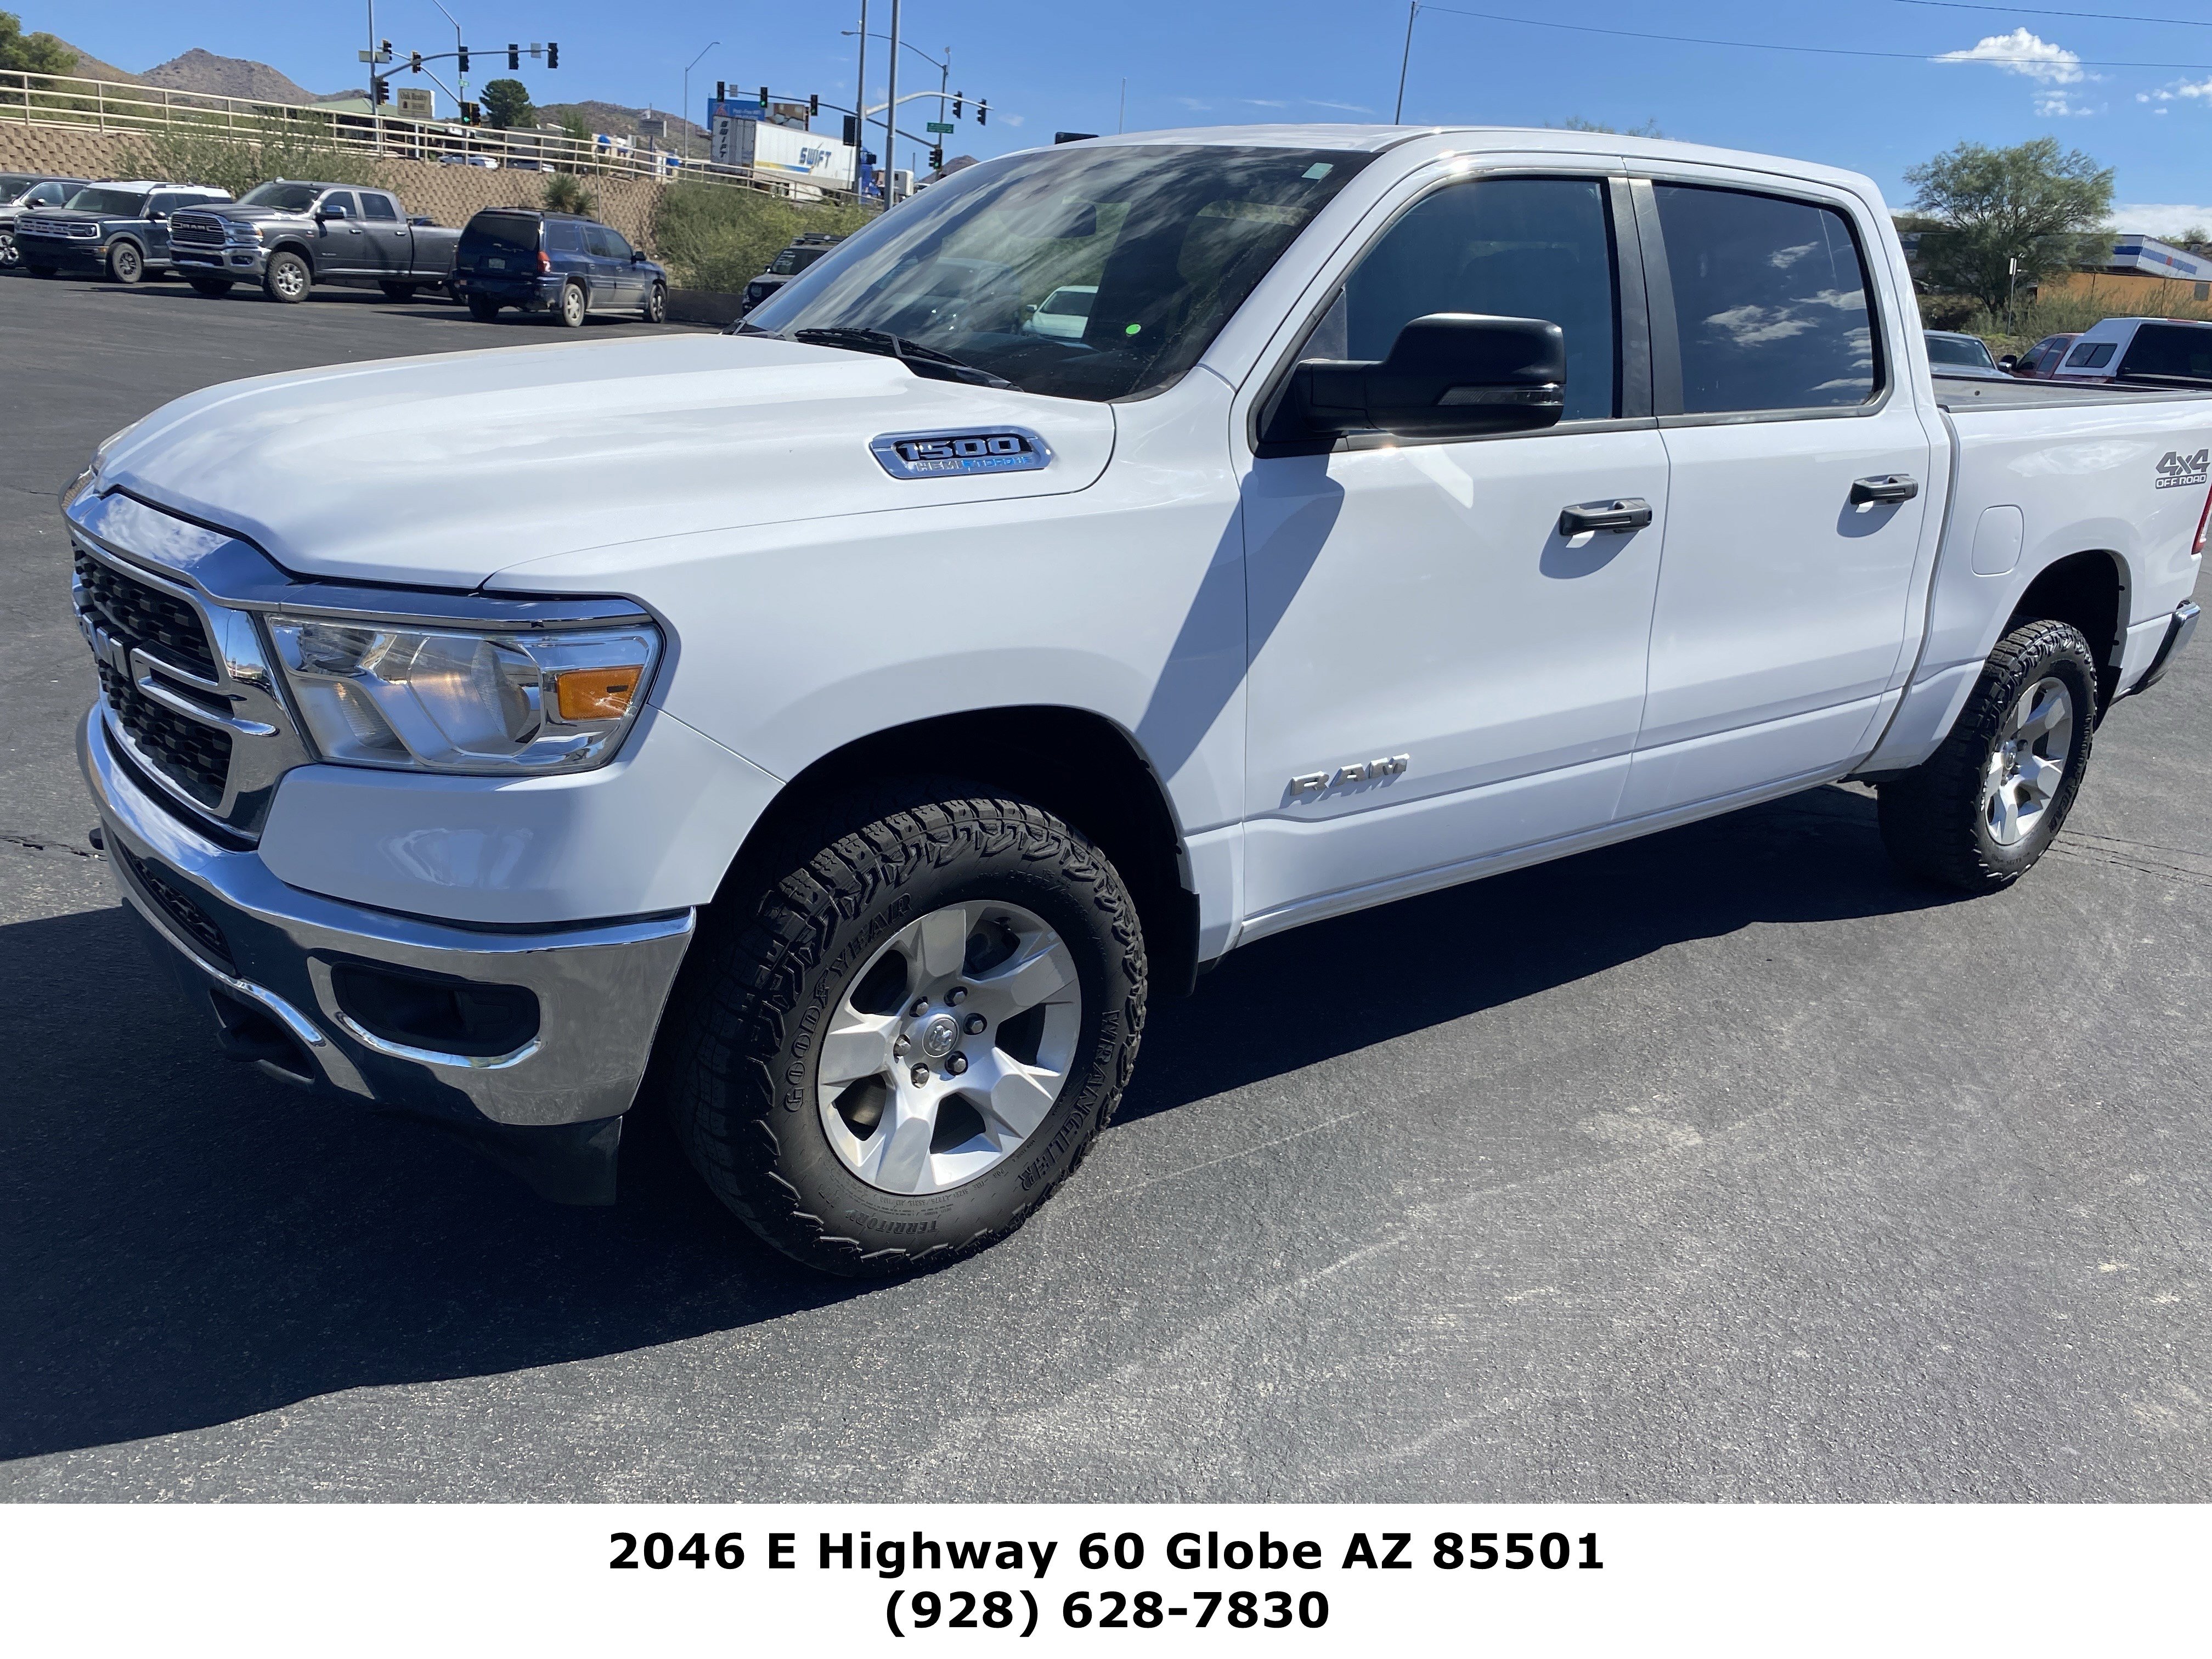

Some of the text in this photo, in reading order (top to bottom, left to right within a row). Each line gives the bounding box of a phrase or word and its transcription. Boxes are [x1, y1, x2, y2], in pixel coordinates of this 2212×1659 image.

[799, 145, 832, 169] SWIFT
[899, 437, 1020, 461] 1500
[2155, 449, 2211, 476] 4x4
[2156, 475, 2207, 488] OFF ROAD
[1290, 753, 1410, 796] RAM
[783, 893, 912, 1112] GOODYEAR
[1018, 1009, 1120, 1191] WRANGLER
[846, 1209, 940, 1234] TERRITORY
